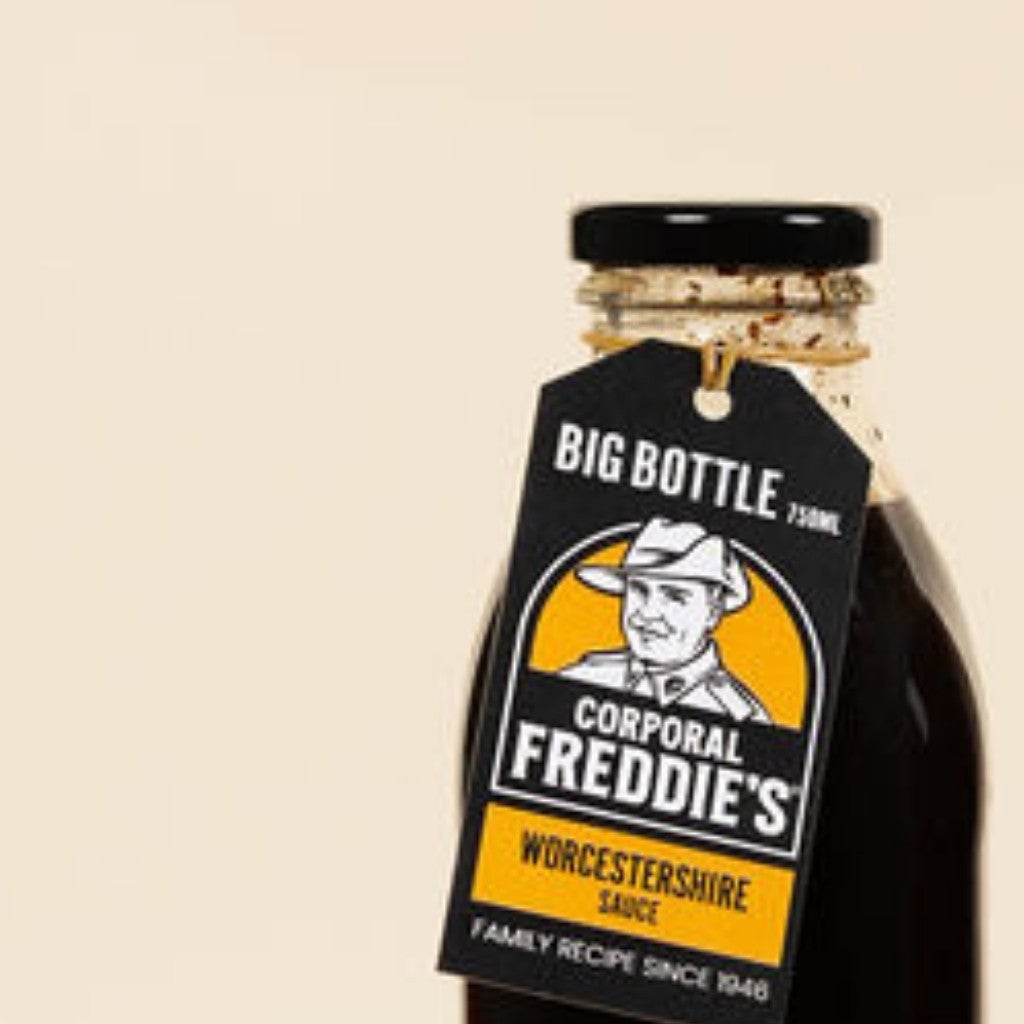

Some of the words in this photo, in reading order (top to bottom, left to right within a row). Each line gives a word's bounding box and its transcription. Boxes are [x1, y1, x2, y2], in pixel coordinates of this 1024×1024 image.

[555, 423, 625, 483] BIG
[630, 440, 785, 519] BOTTLE
[786, 504, 843, 536] 750ML
[573, 695, 744, 765] CORPORAL
[510, 721, 792, 836] FREDDIE'S
[520, 829, 752, 913] WORCESTERSHIRE
[598, 889, 661, 927] SAUCE
[470, 918, 554, 954] FAMILY
[556, 938, 638, 975] RECIPE
[642, 957, 710, 992] SINCE
